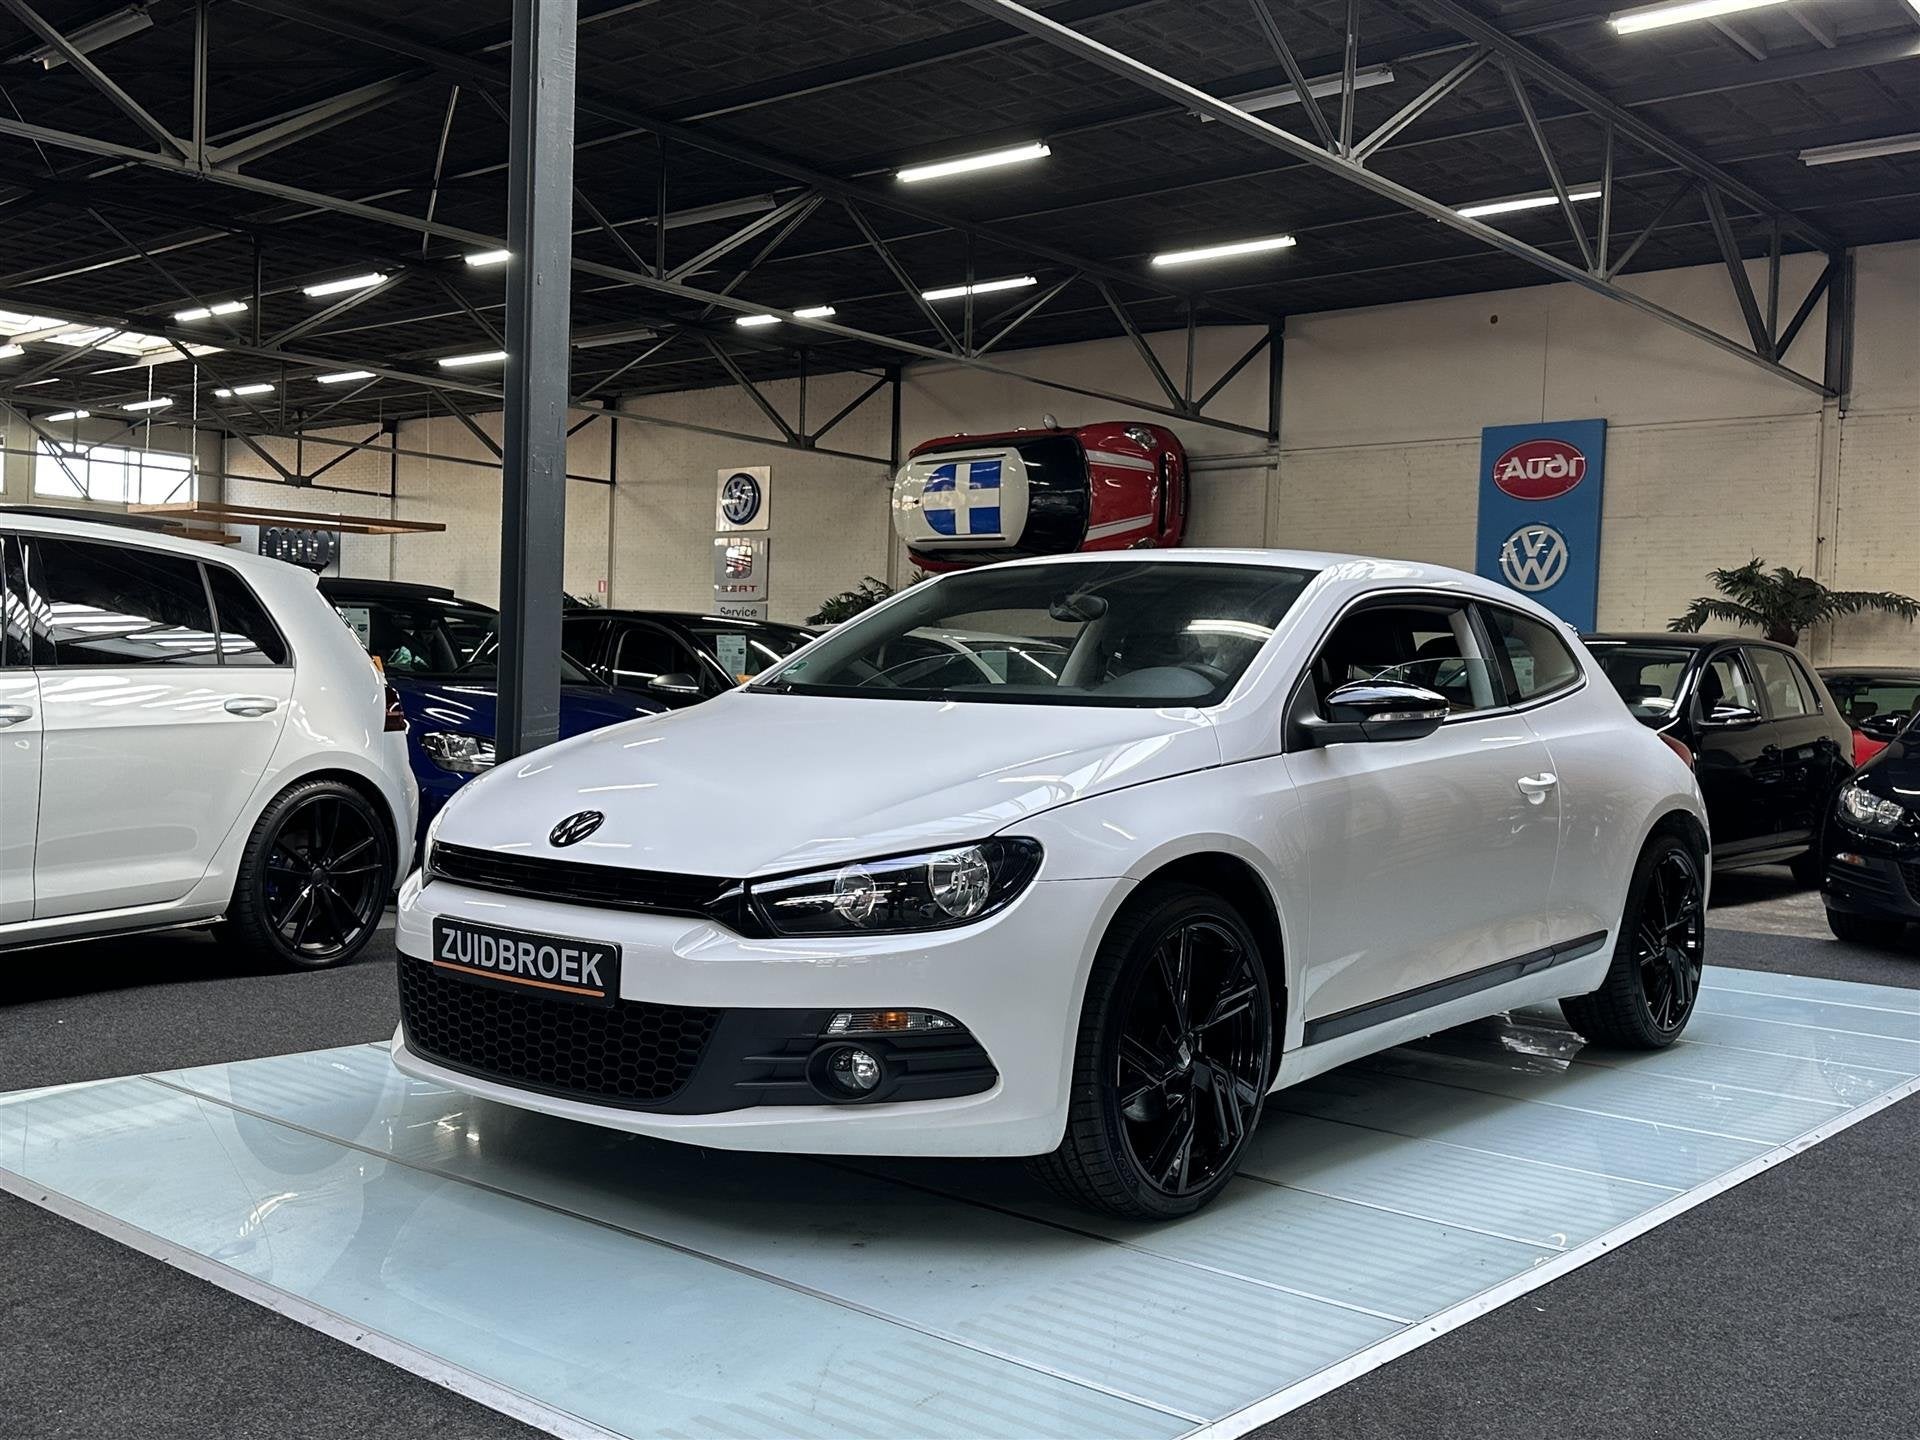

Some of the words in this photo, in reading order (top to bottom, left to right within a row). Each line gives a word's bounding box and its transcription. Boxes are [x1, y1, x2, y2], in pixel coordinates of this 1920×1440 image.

[1502, 453, 1578, 481] Audi
[720, 606, 758, 617] Service
[441, 928, 604, 987] ZUIDBROEK
